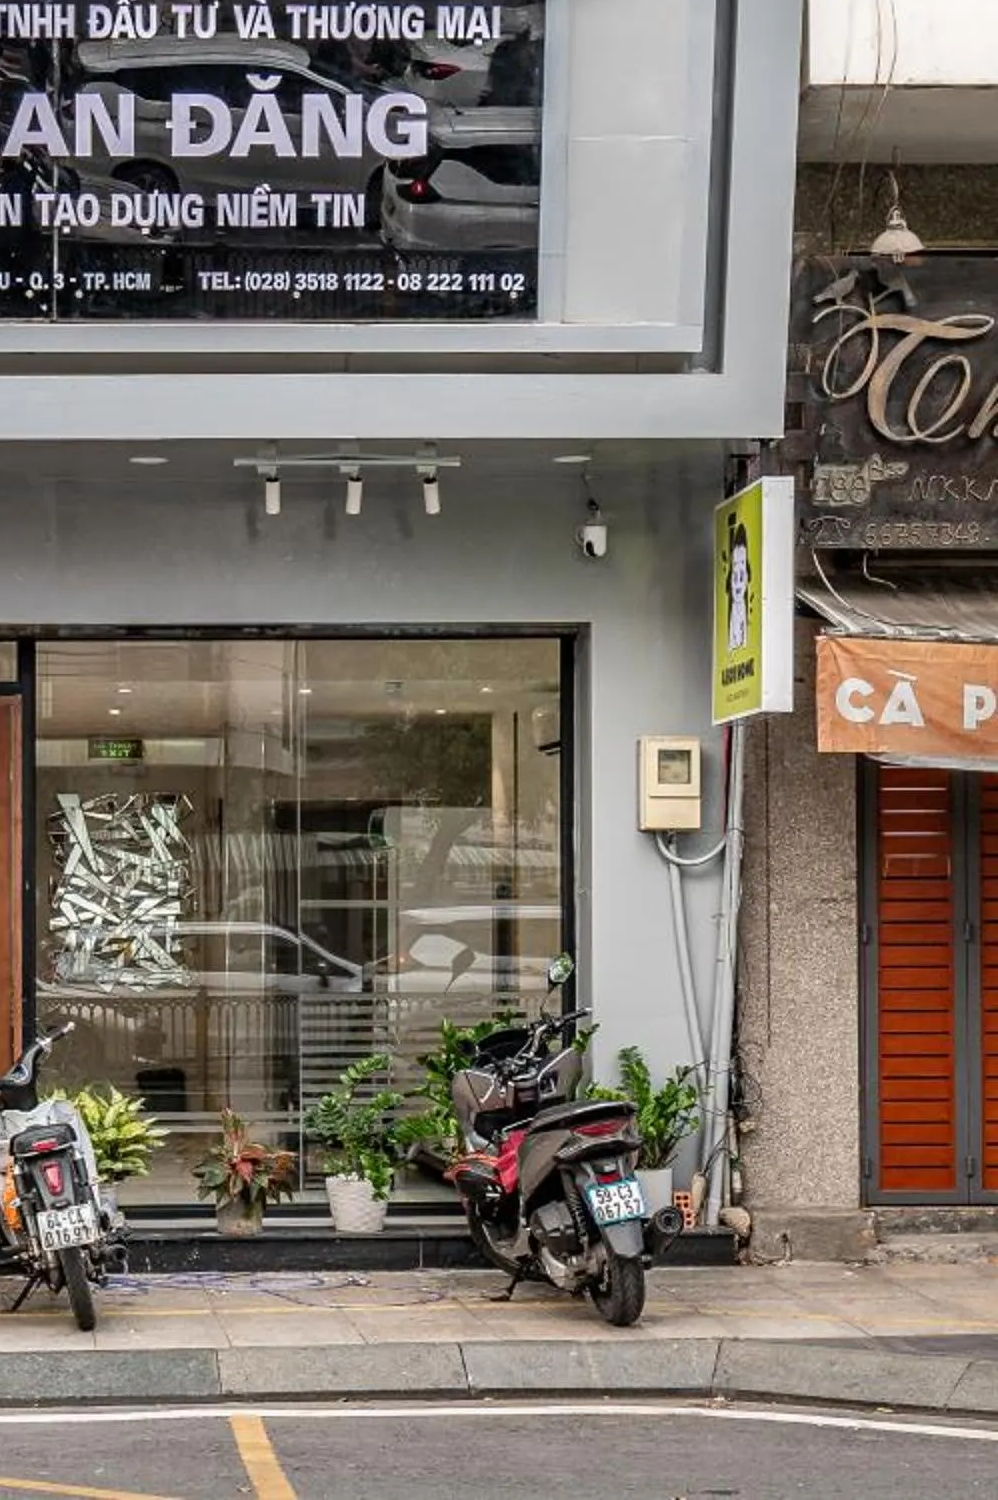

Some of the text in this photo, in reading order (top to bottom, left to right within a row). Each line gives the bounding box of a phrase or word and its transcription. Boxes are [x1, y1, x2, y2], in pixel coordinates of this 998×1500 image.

[172, 0, 220, 39] TƯ
[285, 0, 426, 40] THƯƠNG
[437, 4, 502, 45] MẠI
[165, 73, 429, 158] ĐĂNG
[35, 193, 100, 234] TẠO
[111, 188, 203, 235] DỰNG
[217, 183, 297, 228] NIỀM
[311, 193, 366, 228] TIN
[198, 271, 241, 290] TEL:
[245, 271, 292, 292] (028)
[295, 272, 339, 290] 3518
[398, 272, 422, 290] 08
[427, 272, 463, 290] 222
[469, 272, 495, 290] 111
[501, 273, 525, 291] 02
[835, 669, 926, 727] CÀ
